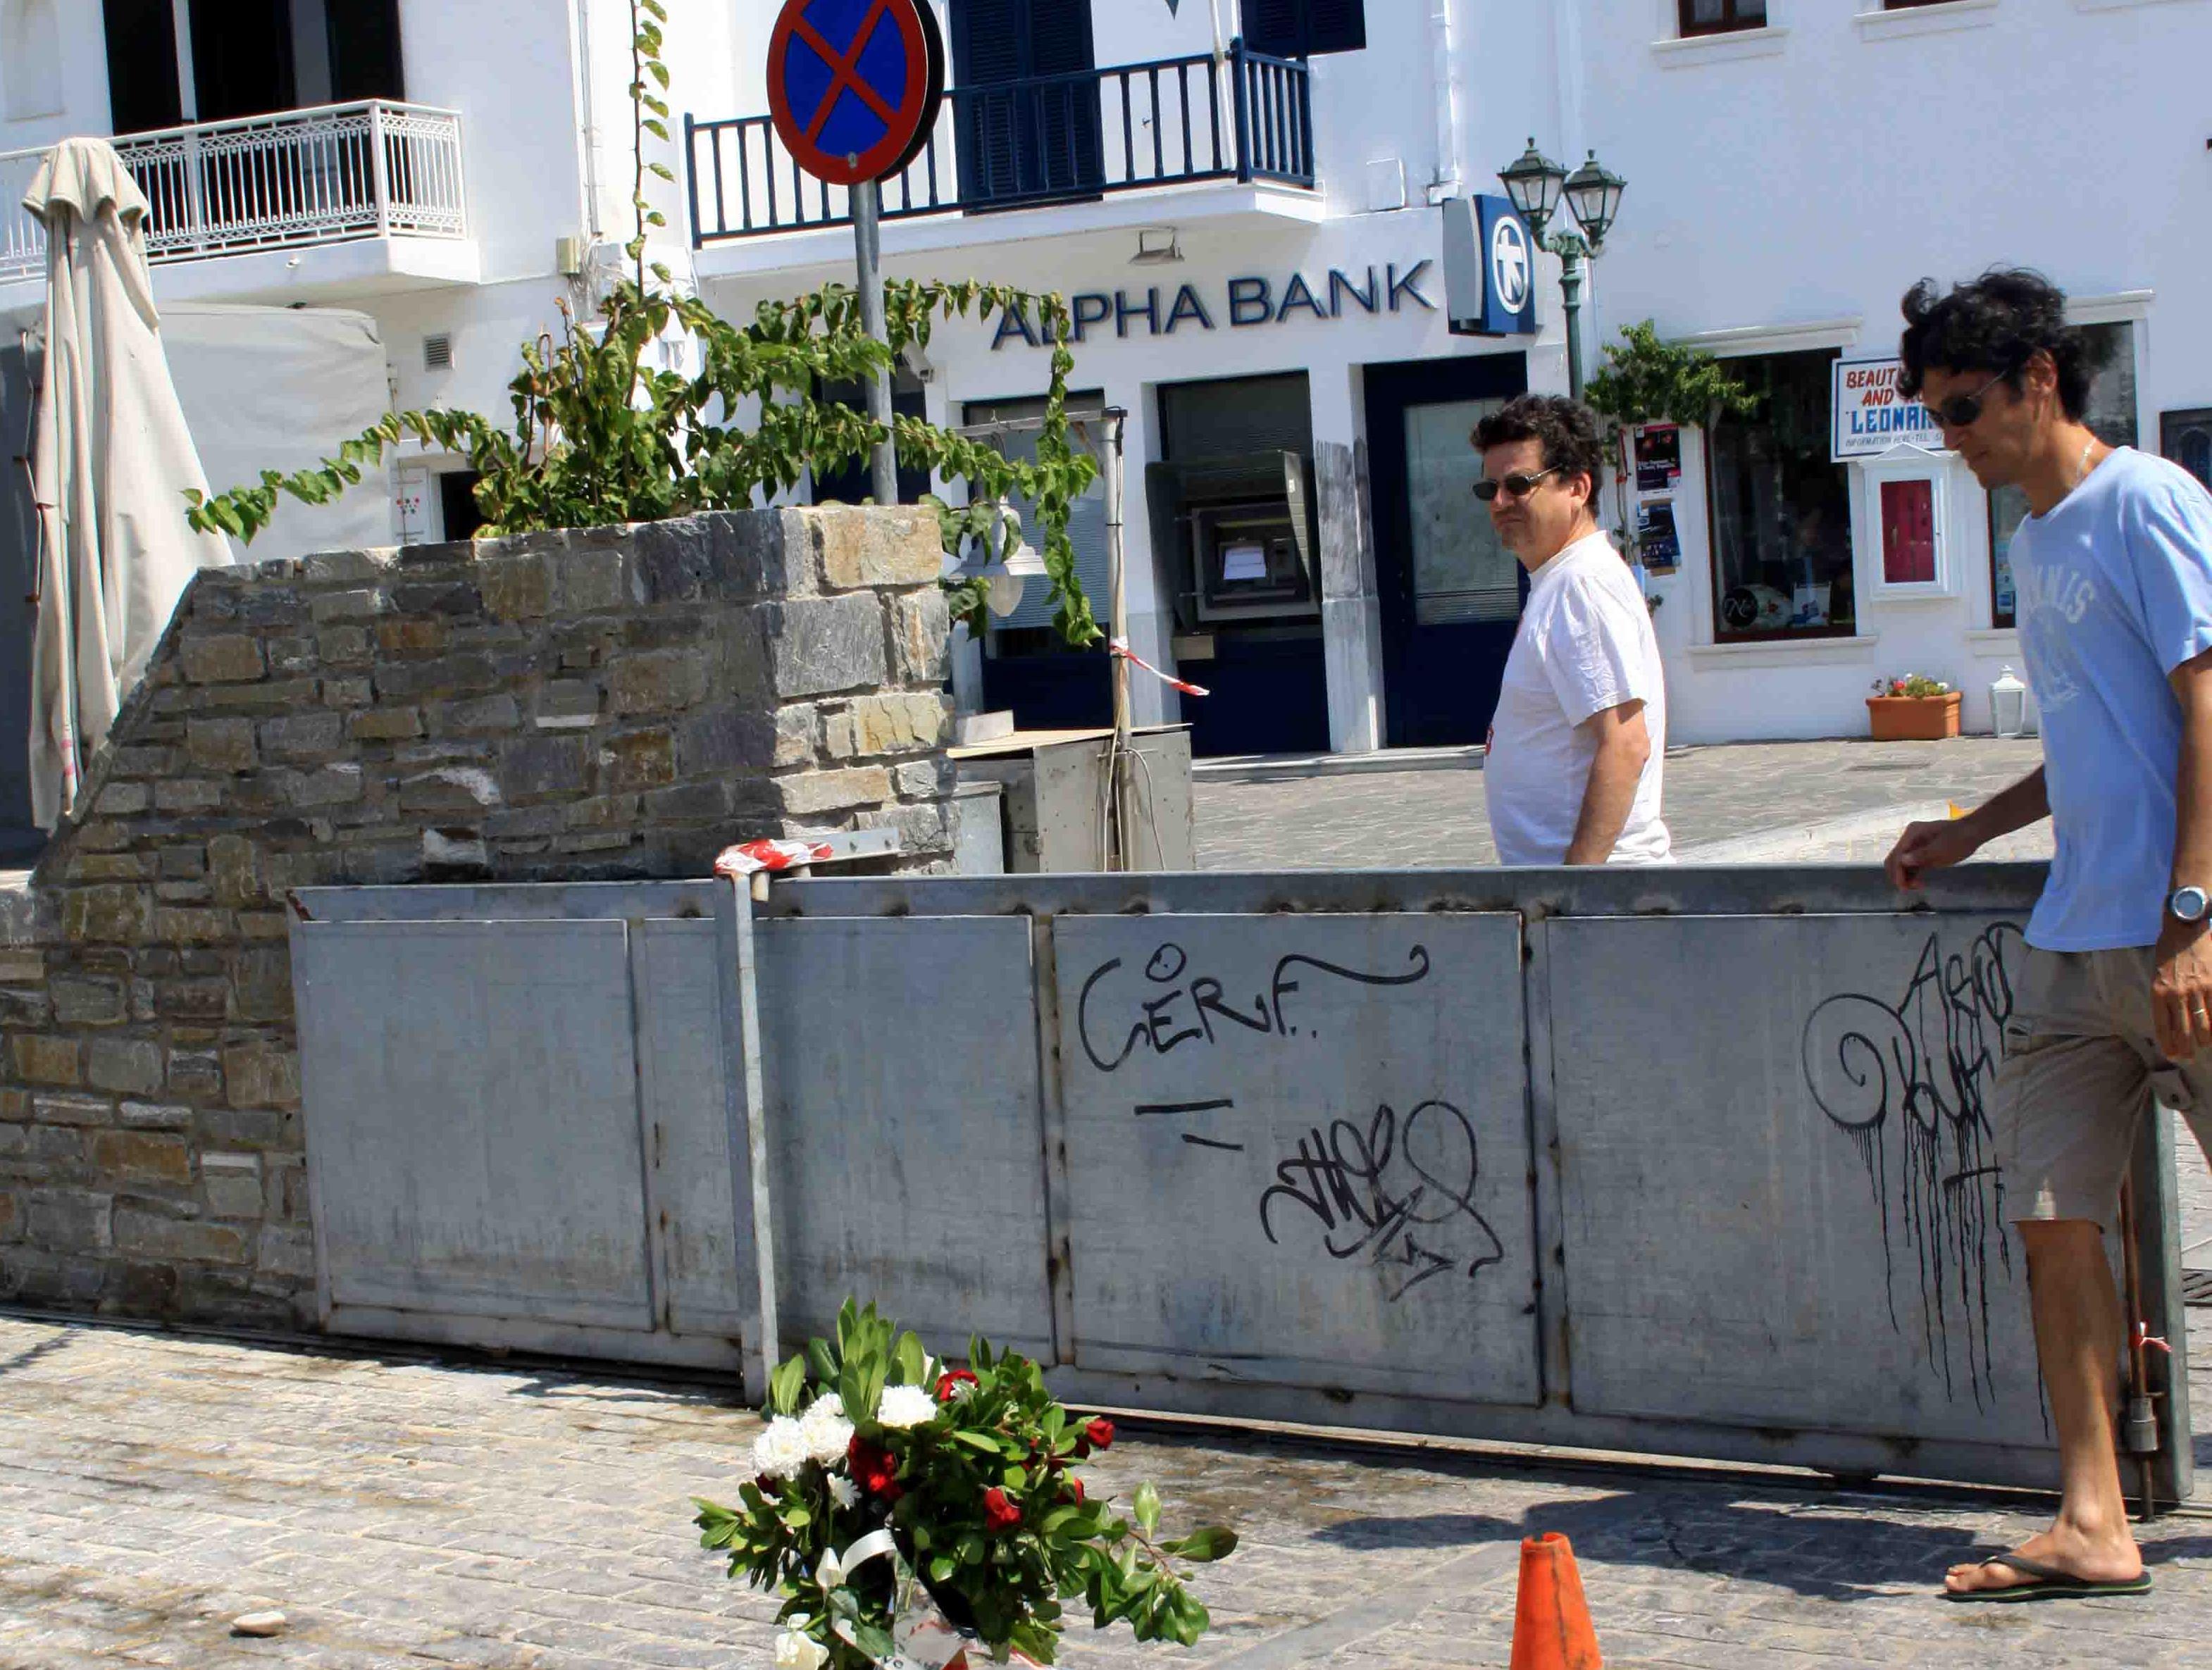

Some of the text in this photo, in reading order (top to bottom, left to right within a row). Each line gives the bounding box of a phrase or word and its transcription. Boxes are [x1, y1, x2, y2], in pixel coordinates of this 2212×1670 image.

[1227, 258, 1440, 328] BANK
[1846, 367, 1901, 389] BEAUT
[1861, 387, 1895, 406] AND
